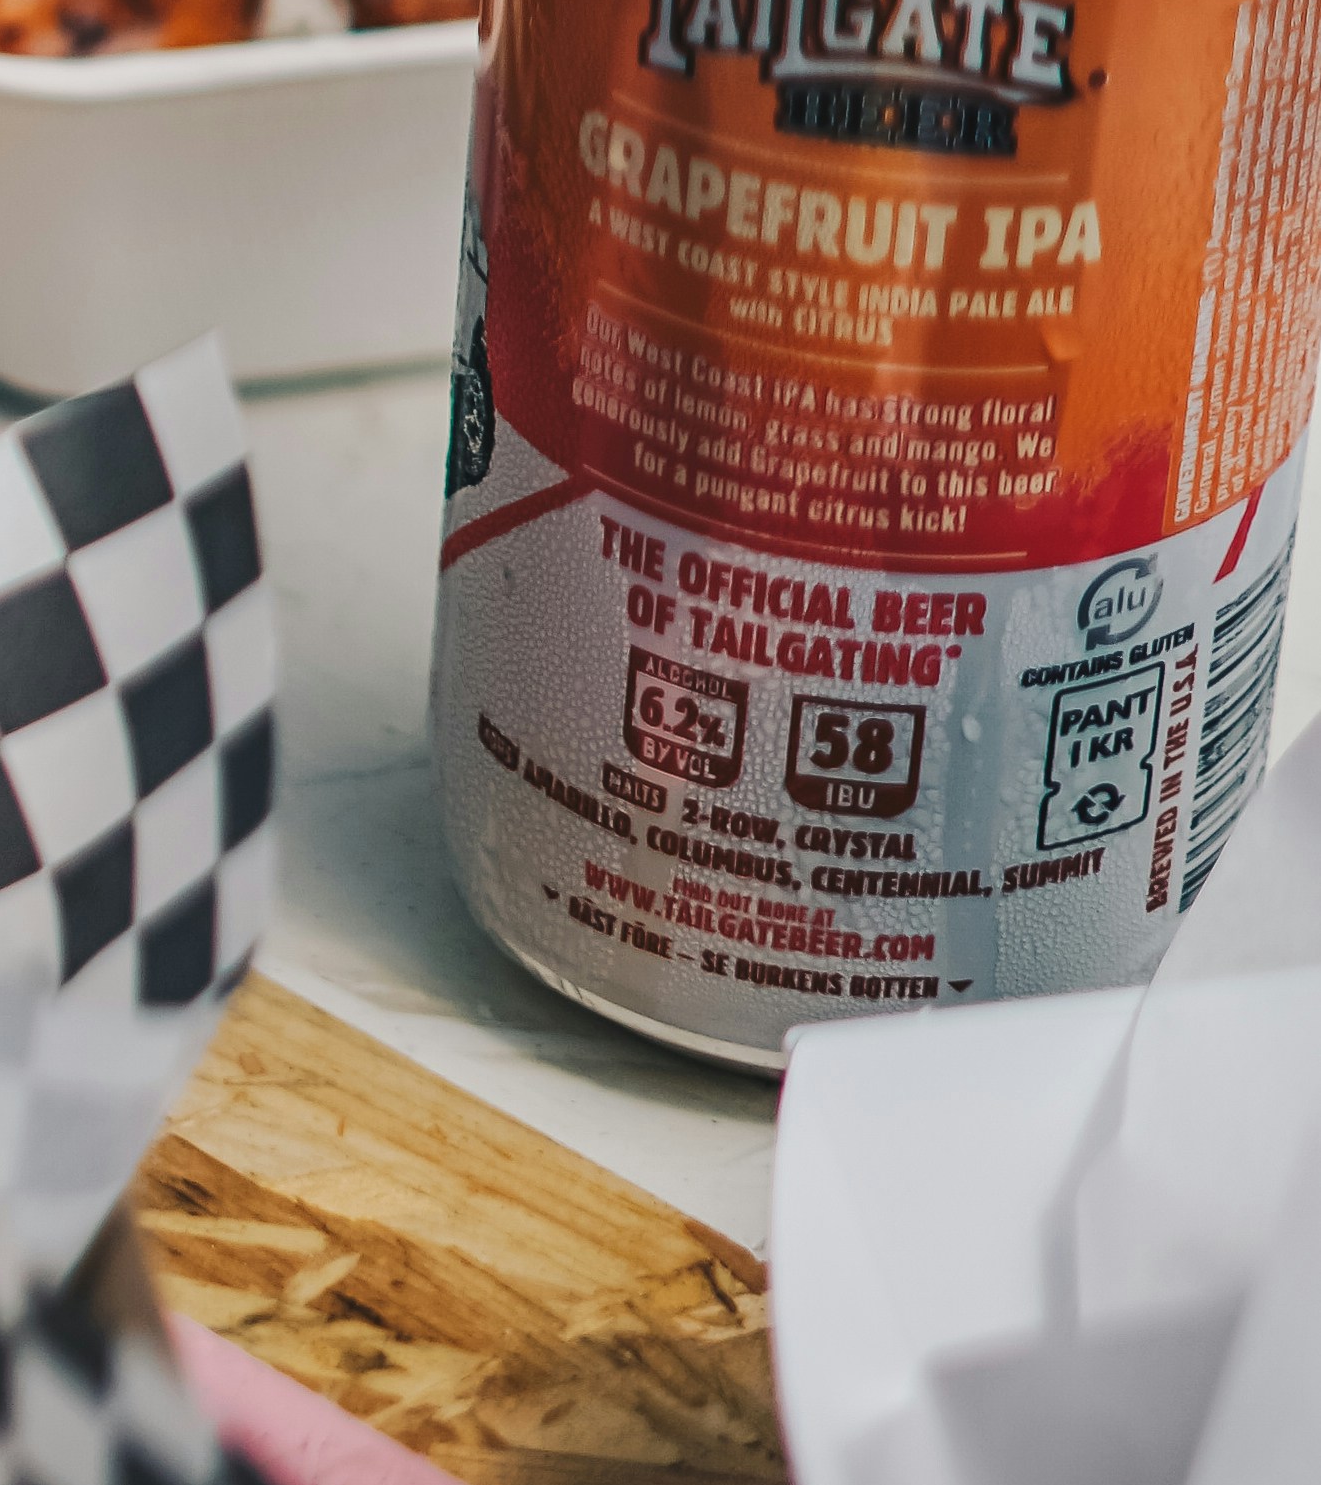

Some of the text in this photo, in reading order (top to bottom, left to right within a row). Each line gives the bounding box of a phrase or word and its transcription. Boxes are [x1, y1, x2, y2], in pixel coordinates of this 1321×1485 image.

[777, 82, 1016, 156] BEER
[578, 111, 1102, 271] GRAPEFRUIT IPA
[588, 196, 1076, 318] A WEST COAST STYLE INDIA PALE ALE
[793, 305, 893, 347] CITRUS
[580, 344, 636, 392] notes
[645, 378, 668, 404] of
[765, 419, 839, 452] grass
[849, 430, 899, 460] and
[1017, 430, 1053, 459] We
[628, 327, 683, 375] West
[692, 355, 763, 401] Coast
[825, 387, 874, 419] has
[981, 394, 1054, 427] floral
[634, 440, 967, 533] for a pungent citrus kick!
[697, 434, 741, 468] add
[750, 444, 888, 495] Grapefruit
[900, 467, 926, 497] to
[937, 469, 989, 499] this
[599, 514, 988, 636] THE OFFICIAL BEER
[1094, 586, 1147, 621] alu
[627, 582, 678, 636] OF
[645, 656, 732, 700] ALCOHOL
[1020, 622, 1195, 689] CONTAINS GLUTEN
[640, 685, 726, 747] 6.2%
[1060, 685, 1157, 737] PANT
[643, 736, 717, 780] BY VOL
[809, 712, 895, 774] 58
[1088, 727, 1135, 763] KR
[1163, 717, 1190, 771] THE
[608, 769, 917, 861] MALTS 2-ROW, CRYSTAL
[826, 782, 876, 810] IBU
[1160, 770, 1183, 804] IN
[647, 824, 1107, 900] COLUMBUS, CENTENNIAL, SUMMIT
[1146, 806, 1179, 914] BREWED
[585, 859, 936, 962] WWW.TAILGATEBEER.COM
[672, 877, 835, 929] FIND OUT MORE AT
[700, 949, 729, 977] SE
[735, 957, 844, 998] BURKENS
[849, 976, 939, 1000] BOTTEN
